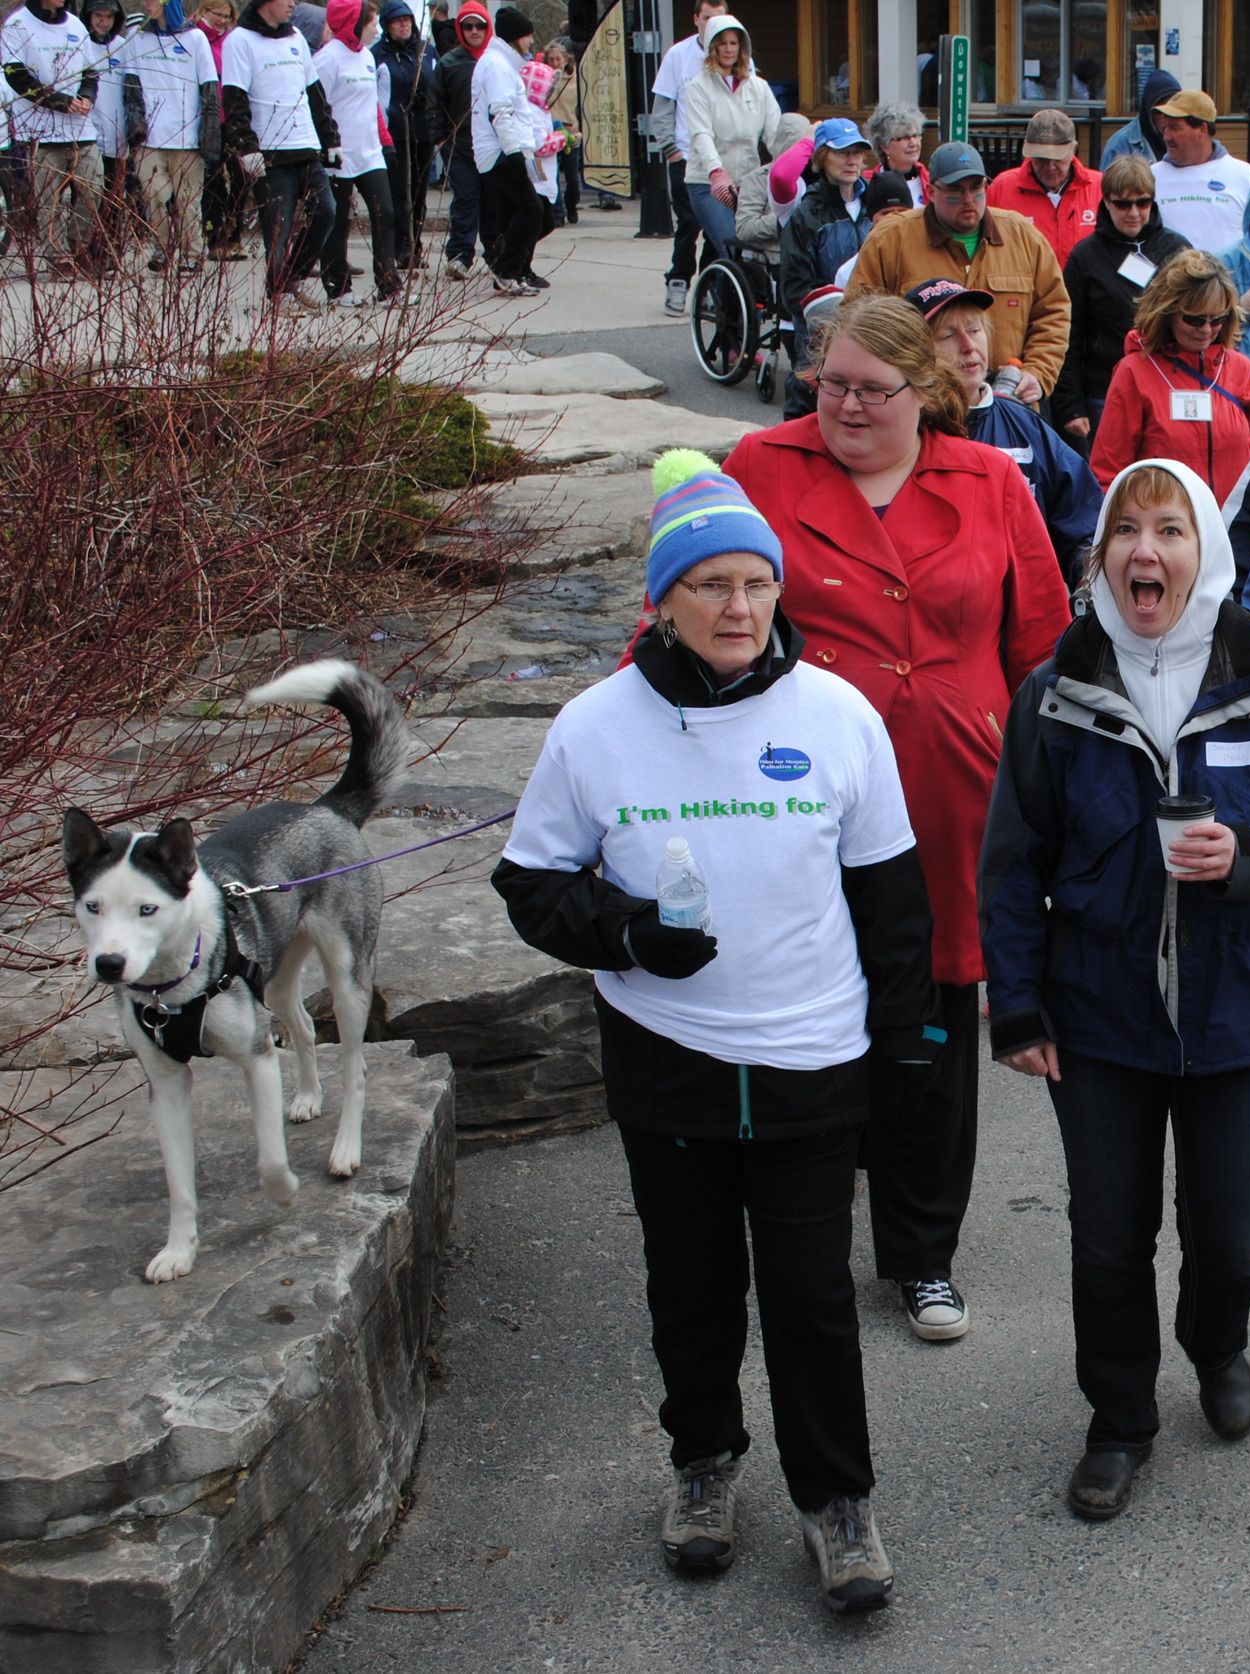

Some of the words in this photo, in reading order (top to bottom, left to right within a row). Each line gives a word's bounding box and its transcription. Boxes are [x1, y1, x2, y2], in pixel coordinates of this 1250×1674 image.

[956, 43, 964, 136] Downtow
[1180, 195, 1212, 203] Hiking
[616, 806, 669, 826] I'm
[680, 798, 777, 819] Hiking
[785, 797, 828, 815] for
